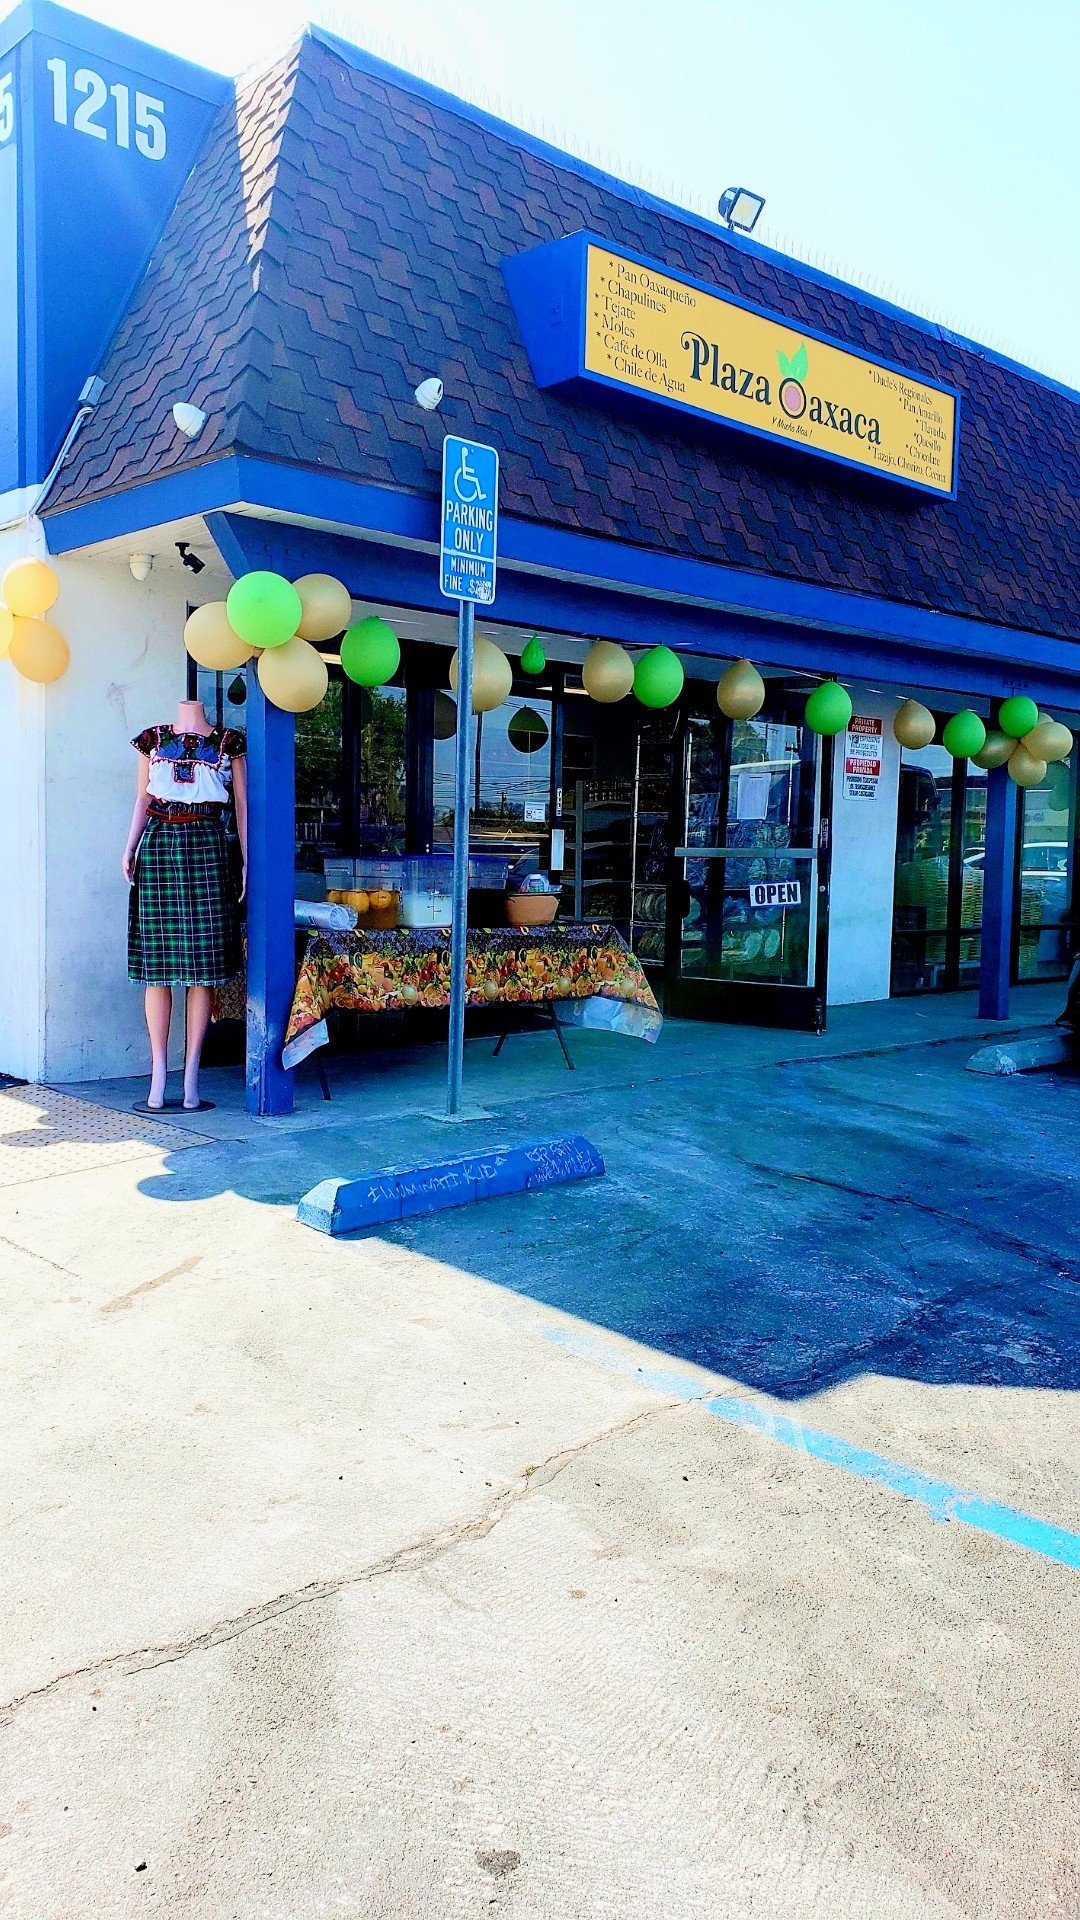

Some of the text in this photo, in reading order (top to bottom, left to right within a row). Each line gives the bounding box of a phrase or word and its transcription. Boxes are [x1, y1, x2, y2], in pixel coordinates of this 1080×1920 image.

[46, 57, 167, 161] 1215
[608, 279, 667, 314] Chapulines
[617, 263, 696, 308] Pan Oaxaqueño
[601, 294, 636, 320] Tejate
[602, 313, 635, 338] Moles
[603, 333, 667, 369] Café de Olla
[614, 356, 686, 393] Chile de Agua
[680, 331, 881, 446] Plaza Oaxaca
[903, 398, 916, 414] Pan
[445, 500, 494, 532] PARKING
[454, 527, 485, 554] ONLY
[450, 556, 487, 579] MINIMUM
[444, 573, 463, 592] FINE
[851, 724, 878, 734] PROPERTY
[854, 717, 875, 727] PRIVATE
[754, 883, 798, 905] OPEN
